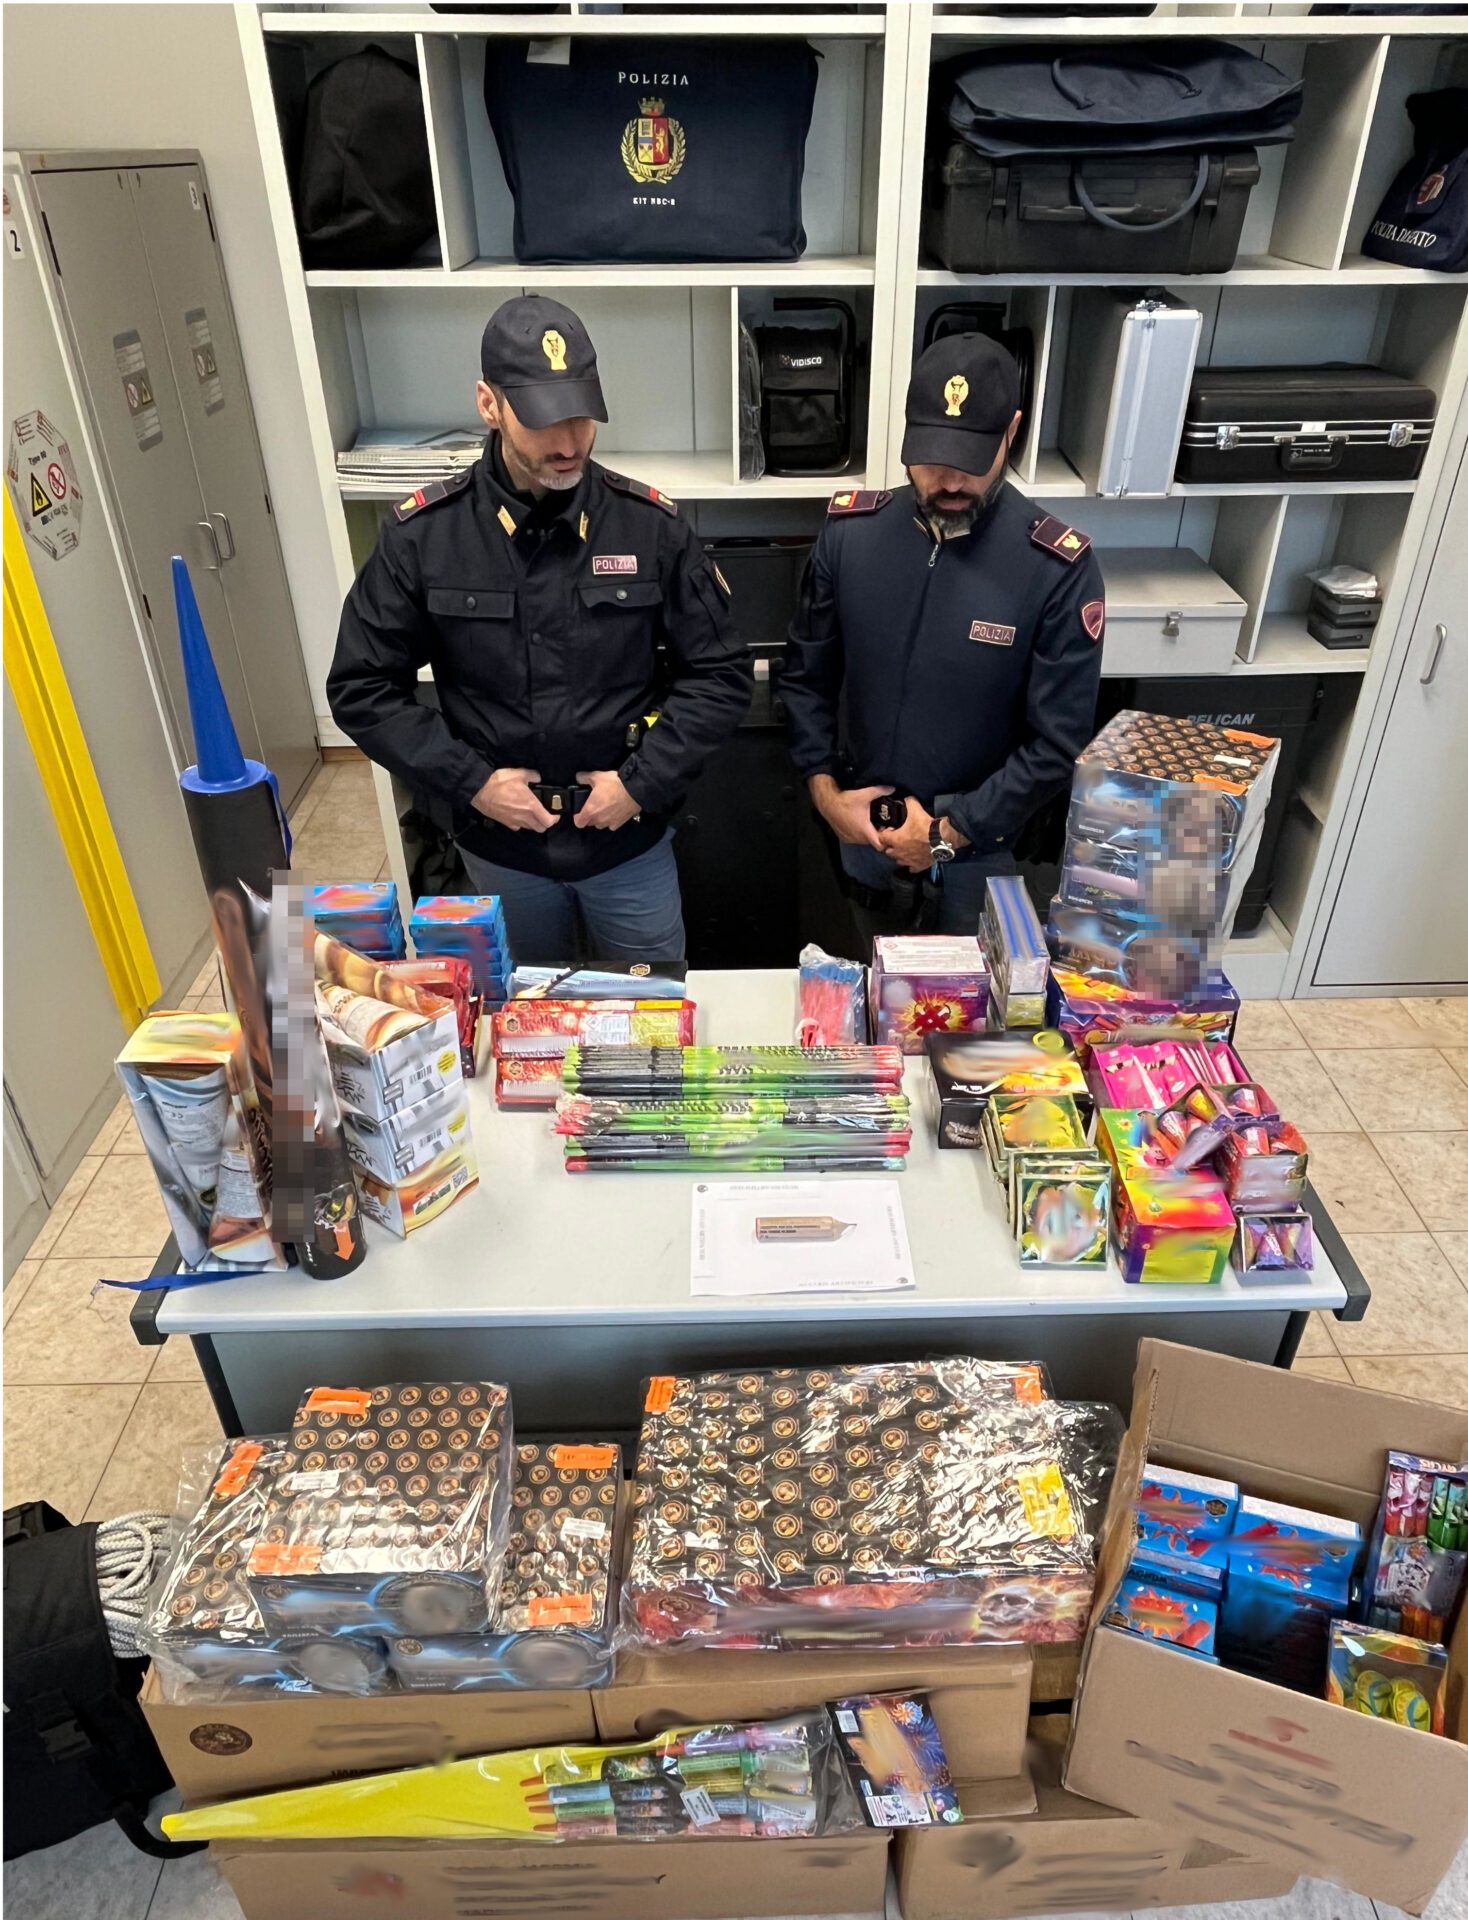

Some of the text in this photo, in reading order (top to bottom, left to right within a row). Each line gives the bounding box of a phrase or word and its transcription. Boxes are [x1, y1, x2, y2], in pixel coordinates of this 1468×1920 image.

[618, 71, 689, 86] POLIZIA
[632, 197, 647, 205] KIT
[9, 229, 22, 252] 2
[790, 356, 822, 367] VIDISCO
[595, 559, 634, 570] POLIZIA
[972, 625, 1011, 641] POLIZIA
[1187, 713, 1255, 726] PELICAN
